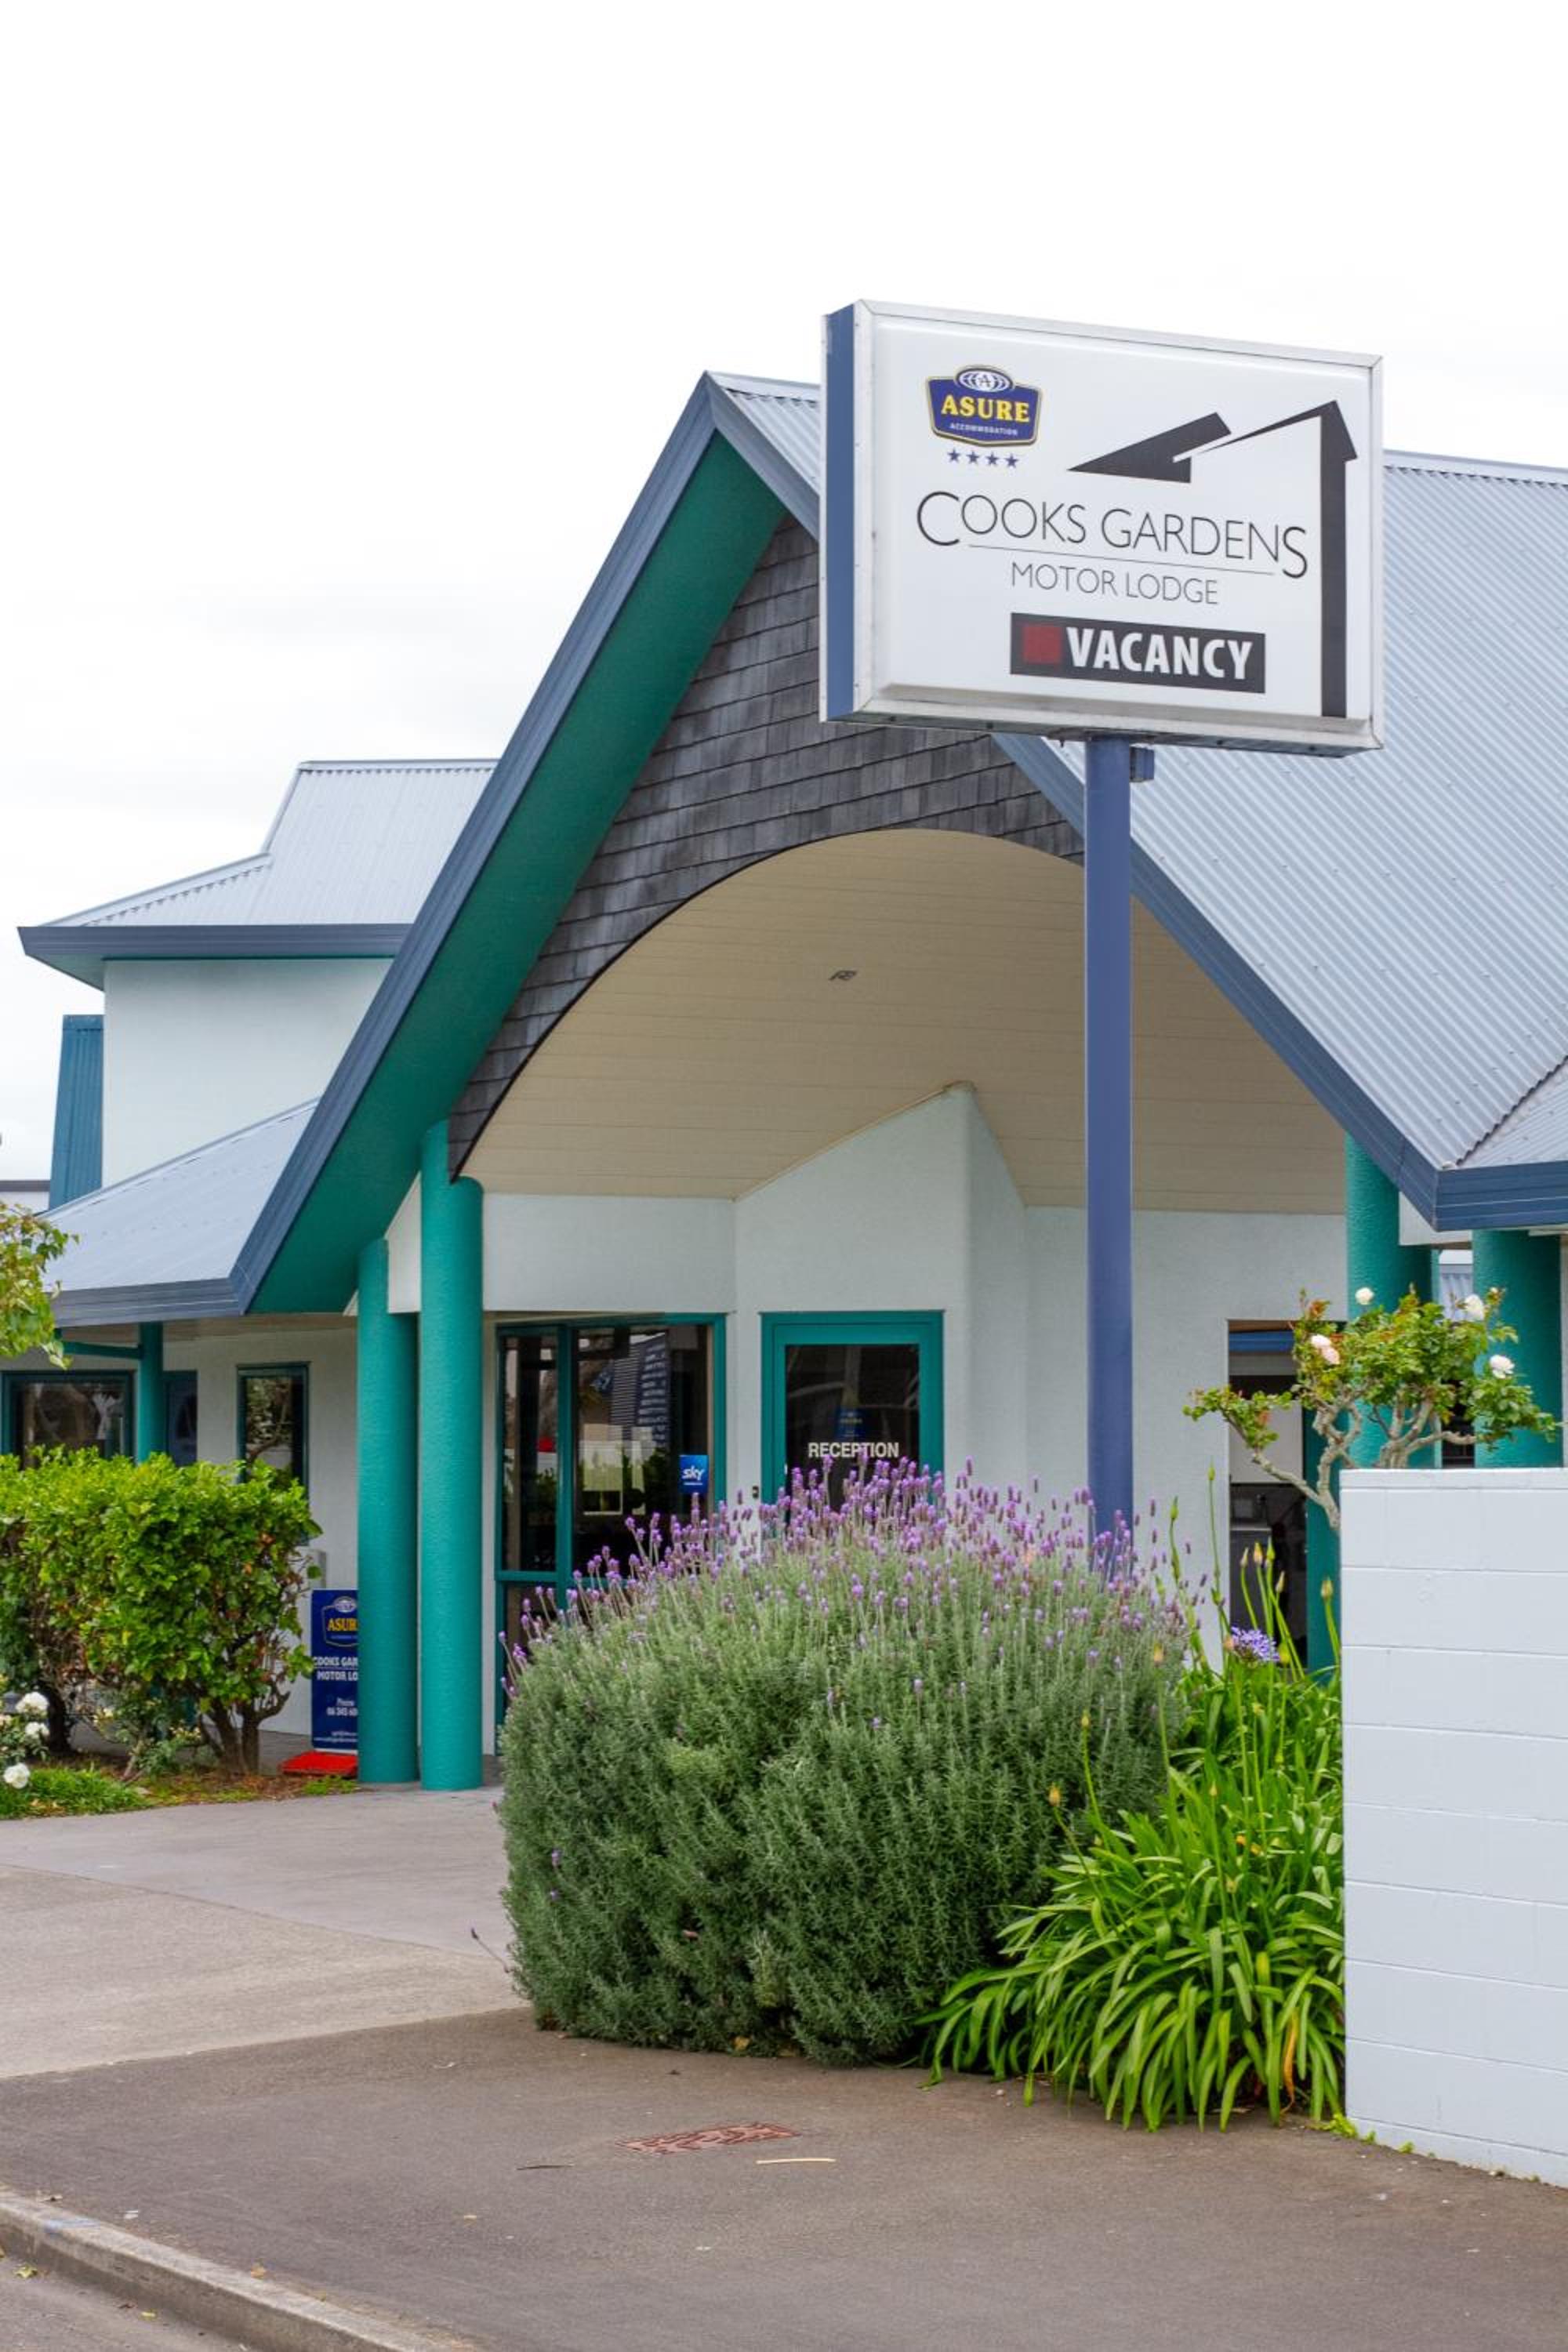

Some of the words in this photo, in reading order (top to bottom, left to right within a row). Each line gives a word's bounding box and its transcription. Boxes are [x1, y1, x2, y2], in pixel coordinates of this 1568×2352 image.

[942, 394, 1029, 423] ASURE
[917, 491, 1087, 546] COOKS
[1101, 508, 1308, 579] GARDENS
[1011, 561, 1118, 597] MOTOR
[1126, 573, 1220, 605] LODGE
[1066, 626, 1253, 681] VACANCY
[808, 1442, 900, 1458] RECEPTION
[328, 1617, 358, 1632] ASUR
[317, 1671, 347, 1682] MOTOR
[347, 1671, 358, 1682] LO
